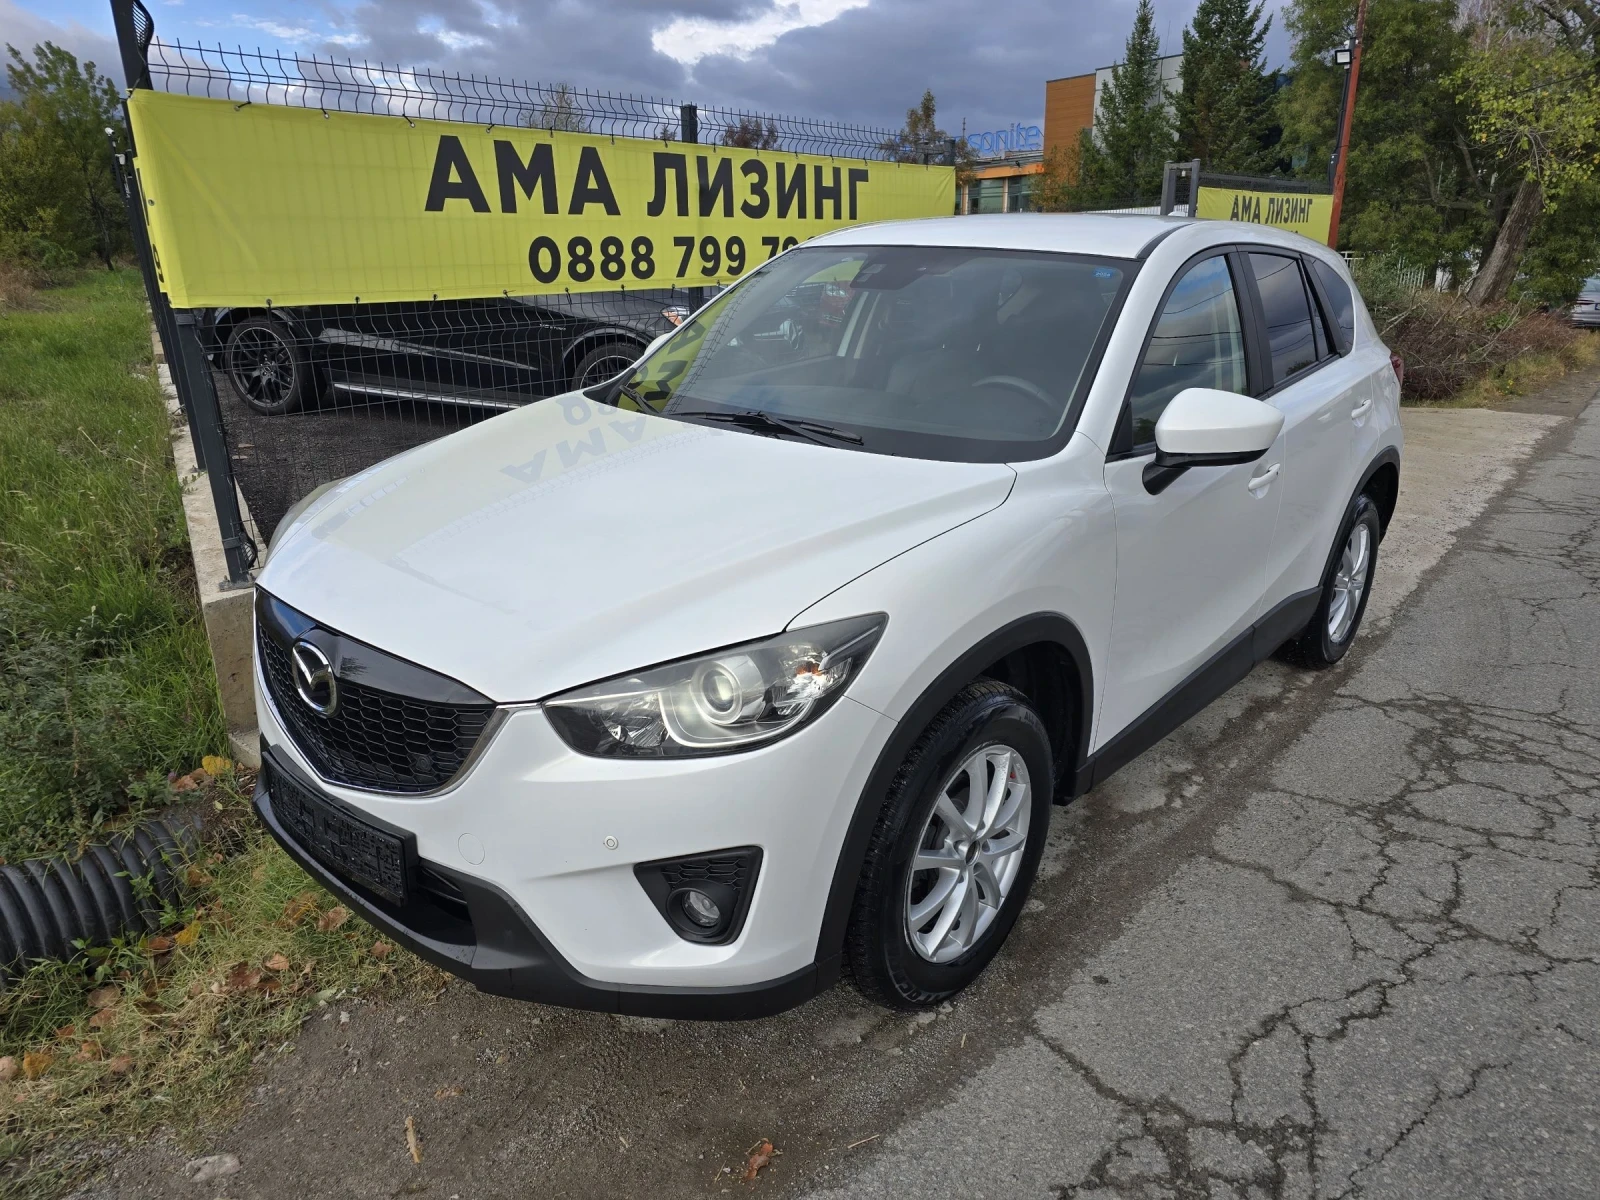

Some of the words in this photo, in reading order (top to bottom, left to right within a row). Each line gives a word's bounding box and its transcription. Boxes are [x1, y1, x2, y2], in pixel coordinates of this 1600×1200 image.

[425, 134, 621, 216] АМА
[647, 151, 869, 221] ЛИЗИНГ
[1230, 195, 1261, 224] АМА
[1265, 197, 1313, 224] ЛИЗИНГ
[528, 235, 656, 284] 0888
[673, 235, 746, 277] 799
